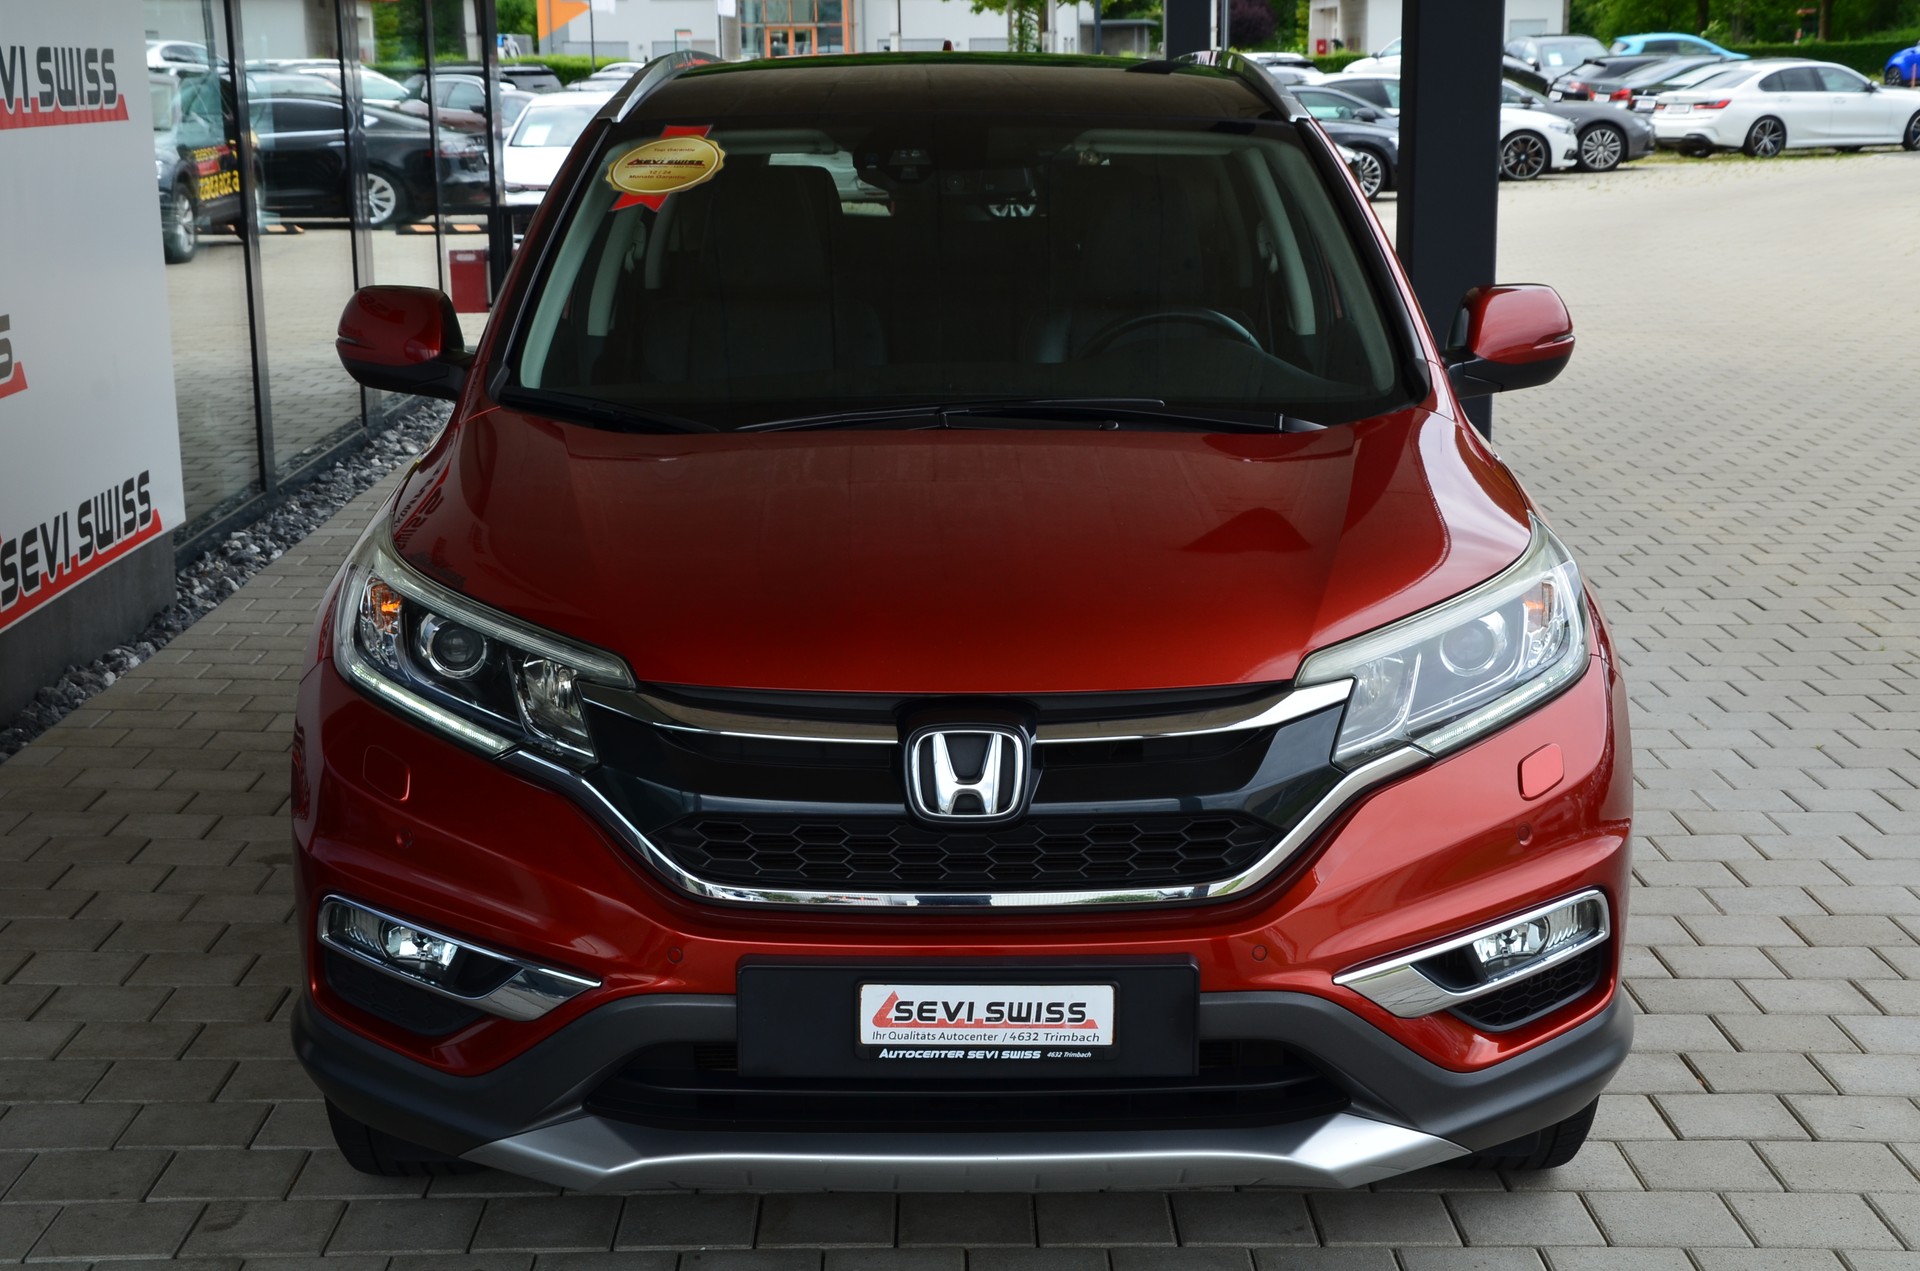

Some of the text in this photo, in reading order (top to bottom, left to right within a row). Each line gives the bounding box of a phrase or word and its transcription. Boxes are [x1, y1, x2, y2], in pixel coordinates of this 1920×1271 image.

[36, 46, 117, 107] SWISS
[1, 470, 152, 607] SEVI SWISS
[893, 1001, 1087, 1023] SEVI SWISS
[872, 1031, 887, 1041] Ihr
[888, 1031, 937, 1042] Qualitäts
[938, 1031, 999, 1042] Autocenter
[1043, 1032, 1100, 1042] Trimbach
[879, 1048, 966, 1059] AUTOCENTER
[967, 1050, 999, 1059] SEVI
[1001, 1050, 1041, 1059] SWISS
